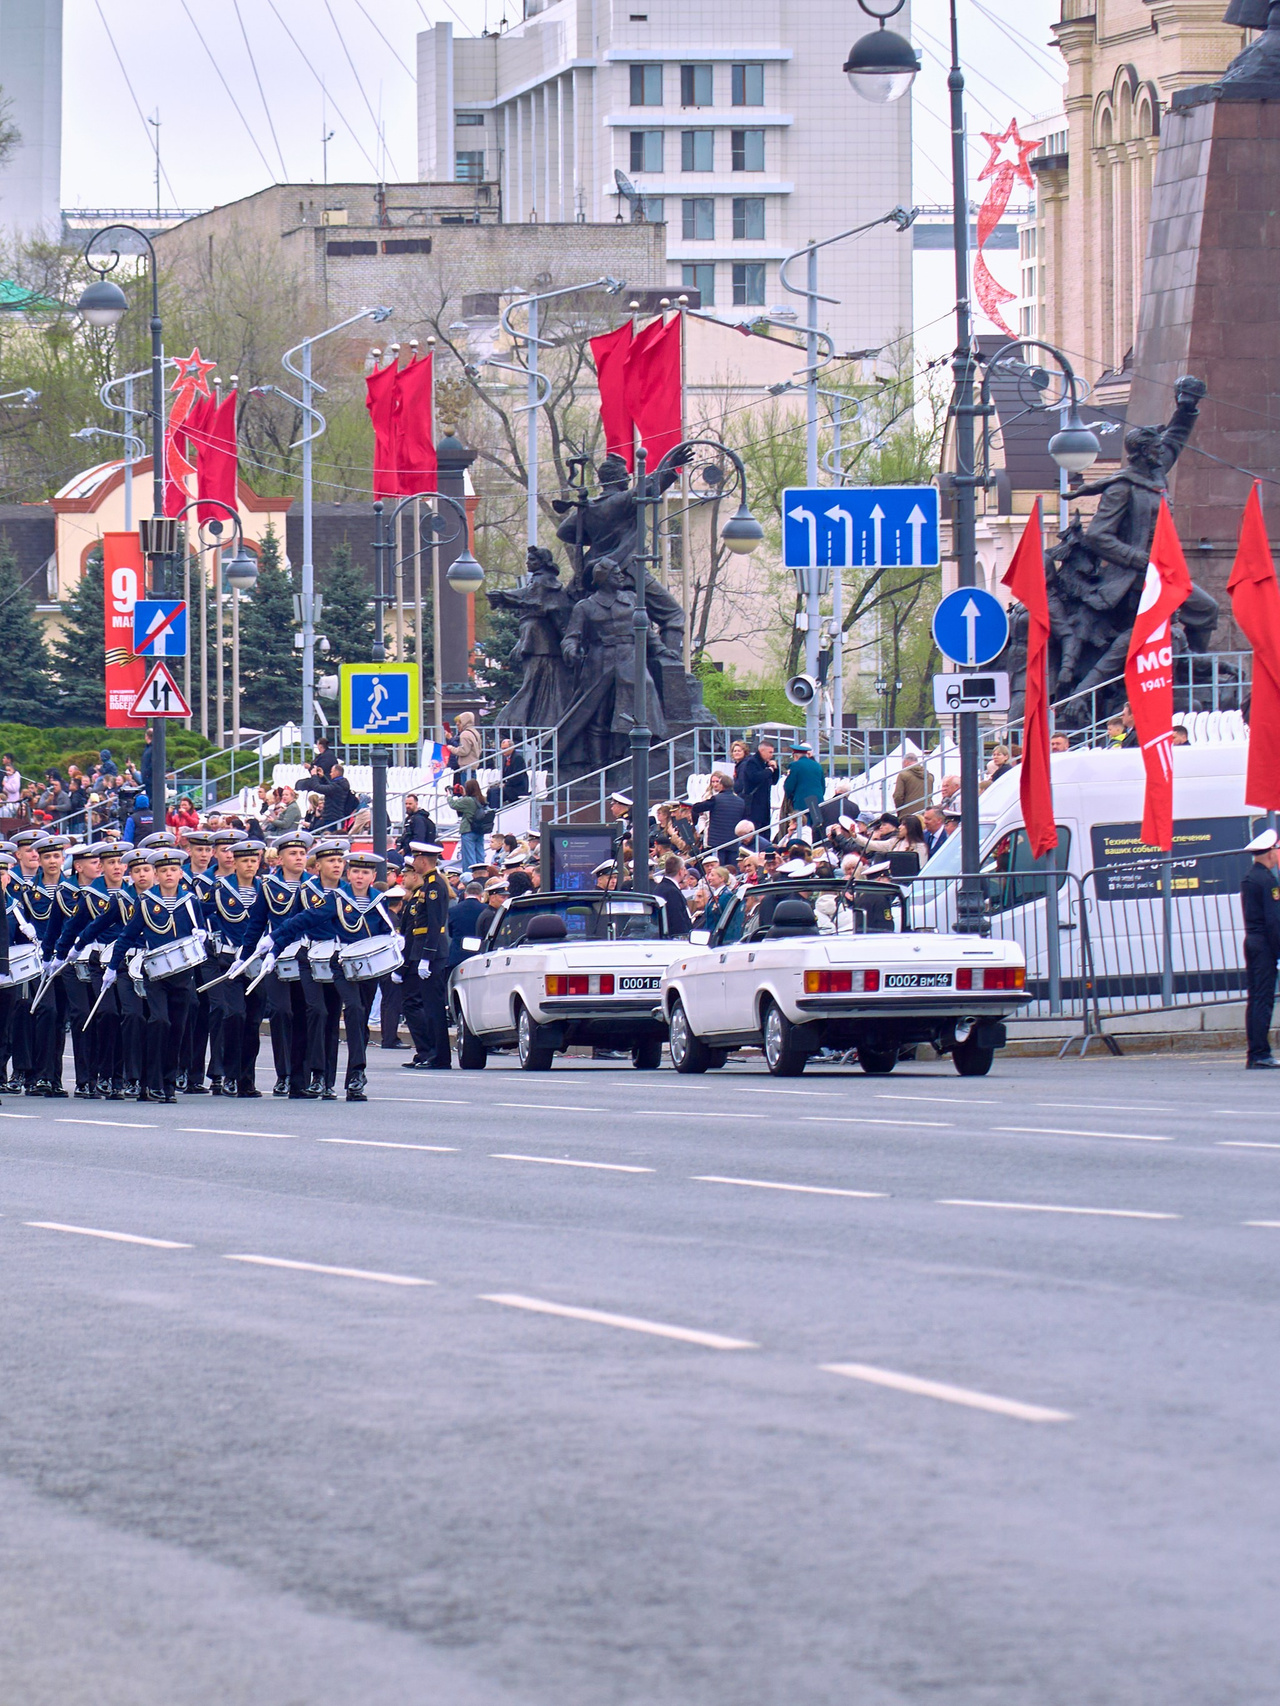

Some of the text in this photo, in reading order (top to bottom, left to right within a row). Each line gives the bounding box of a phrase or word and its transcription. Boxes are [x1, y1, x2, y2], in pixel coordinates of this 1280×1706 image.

[111, 567, 137, 613] 9
[622, 978, 651, 989] 0001
[888, 975, 918, 987] 0002
